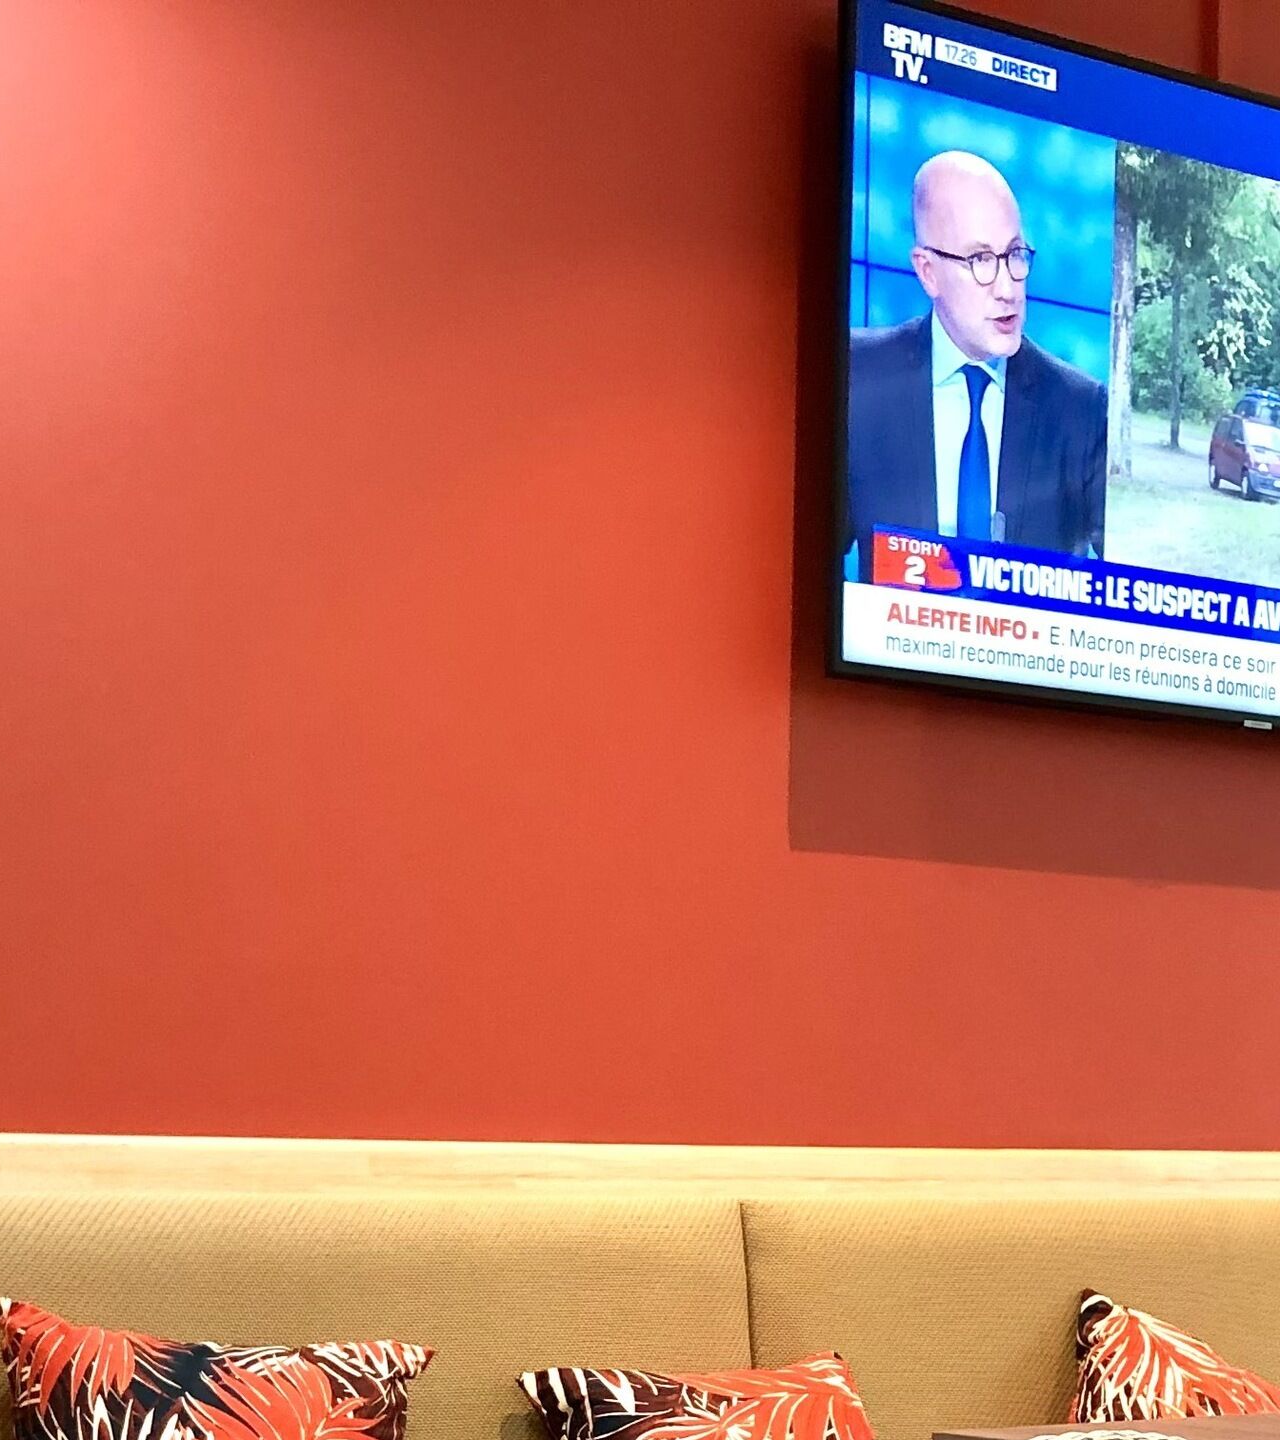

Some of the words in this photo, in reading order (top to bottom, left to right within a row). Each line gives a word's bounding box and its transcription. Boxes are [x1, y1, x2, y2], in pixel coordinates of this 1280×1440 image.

[883, 23, 933, 59] BFM
[991, 56, 1051, 86] DIRECT
[887, 535, 943, 558] STORY
[903, 555, 927, 586] 2
[1105, 575, 1130, 610] LE
[1132, 579, 1232, 624] SUSPECT
[1233, 595, 1251, 628] A
[886, 602, 971, 633] ALERTE
[975, 614, 1027, 640] INFO
[1049, 625, 1065, 646] E.
[1069, 628, 1135, 655] Macron
[1140, 642, 1218, 668] précisera
[1223, 653, 1242, 670] ce
[1246, 656, 1277, 674] soir
[886, 635, 955, 659] maximal
[960, 645, 1066, 674] recommandé
[1069, 659, 1105, 679] pour
[1109, 661, 1131, 683] les
[1135, 666, 1200, 691] réunions
[1203, 674, 1212, 693] à
[1216, 676, 1276, 701] domicile
